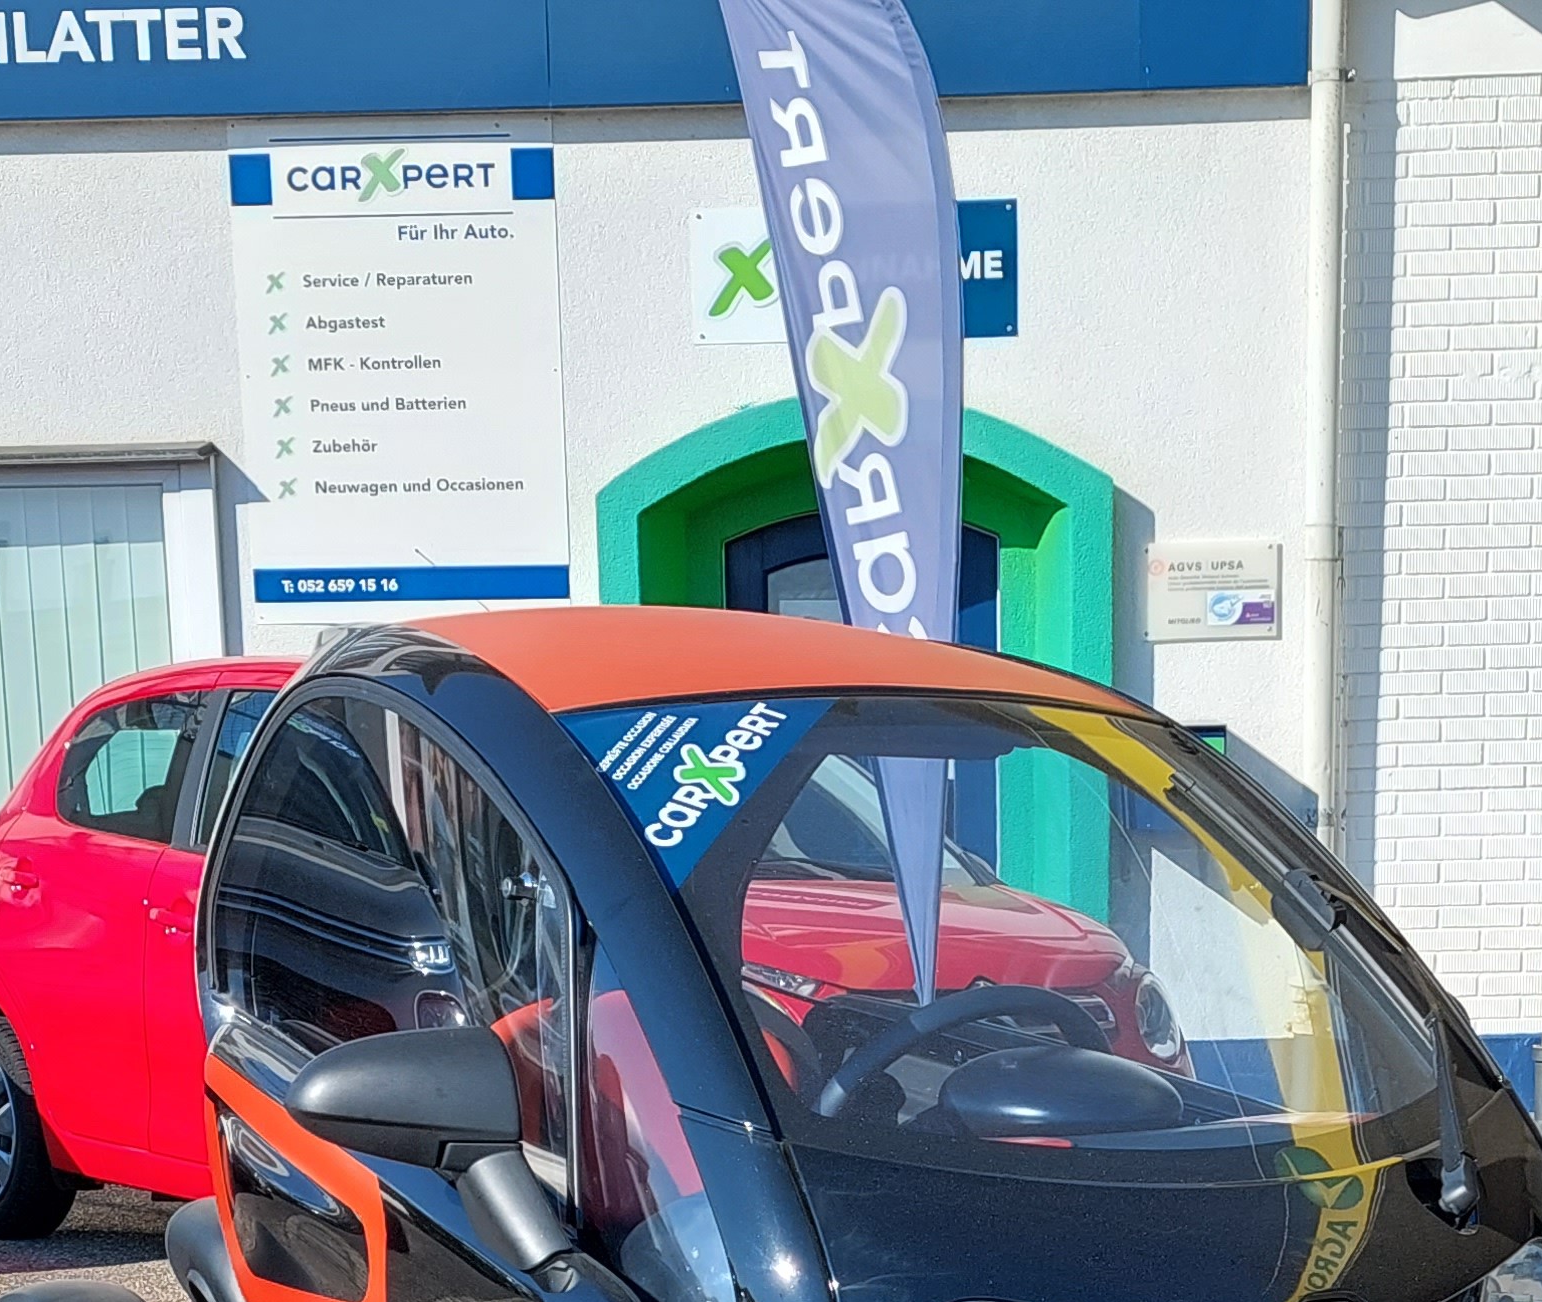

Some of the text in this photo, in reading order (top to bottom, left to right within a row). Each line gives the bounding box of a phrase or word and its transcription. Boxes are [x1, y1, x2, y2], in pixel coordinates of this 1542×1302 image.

[397, 223, 515, 241] Für Ihr Auto.
[961, 250, 1003, 280] ME
[303, 273, 360, 288] Service
[376, 272, 473, 289] Reparaturen
[306, 315, 386, 332] Abgastest
[308, 357, 345, 372] MFK
[359, 356, 441, 371] Kontrollen
[310, 396, 467, 413] Pneus und Batterien
[312, 438, 378, 454] Zubehör
[315, 477, 524, 496] Neuwagen und Occasionen
[1210, 559, 1244, 572] UPSA
[281, 578, 398, 593] T: 052 659 15 16
